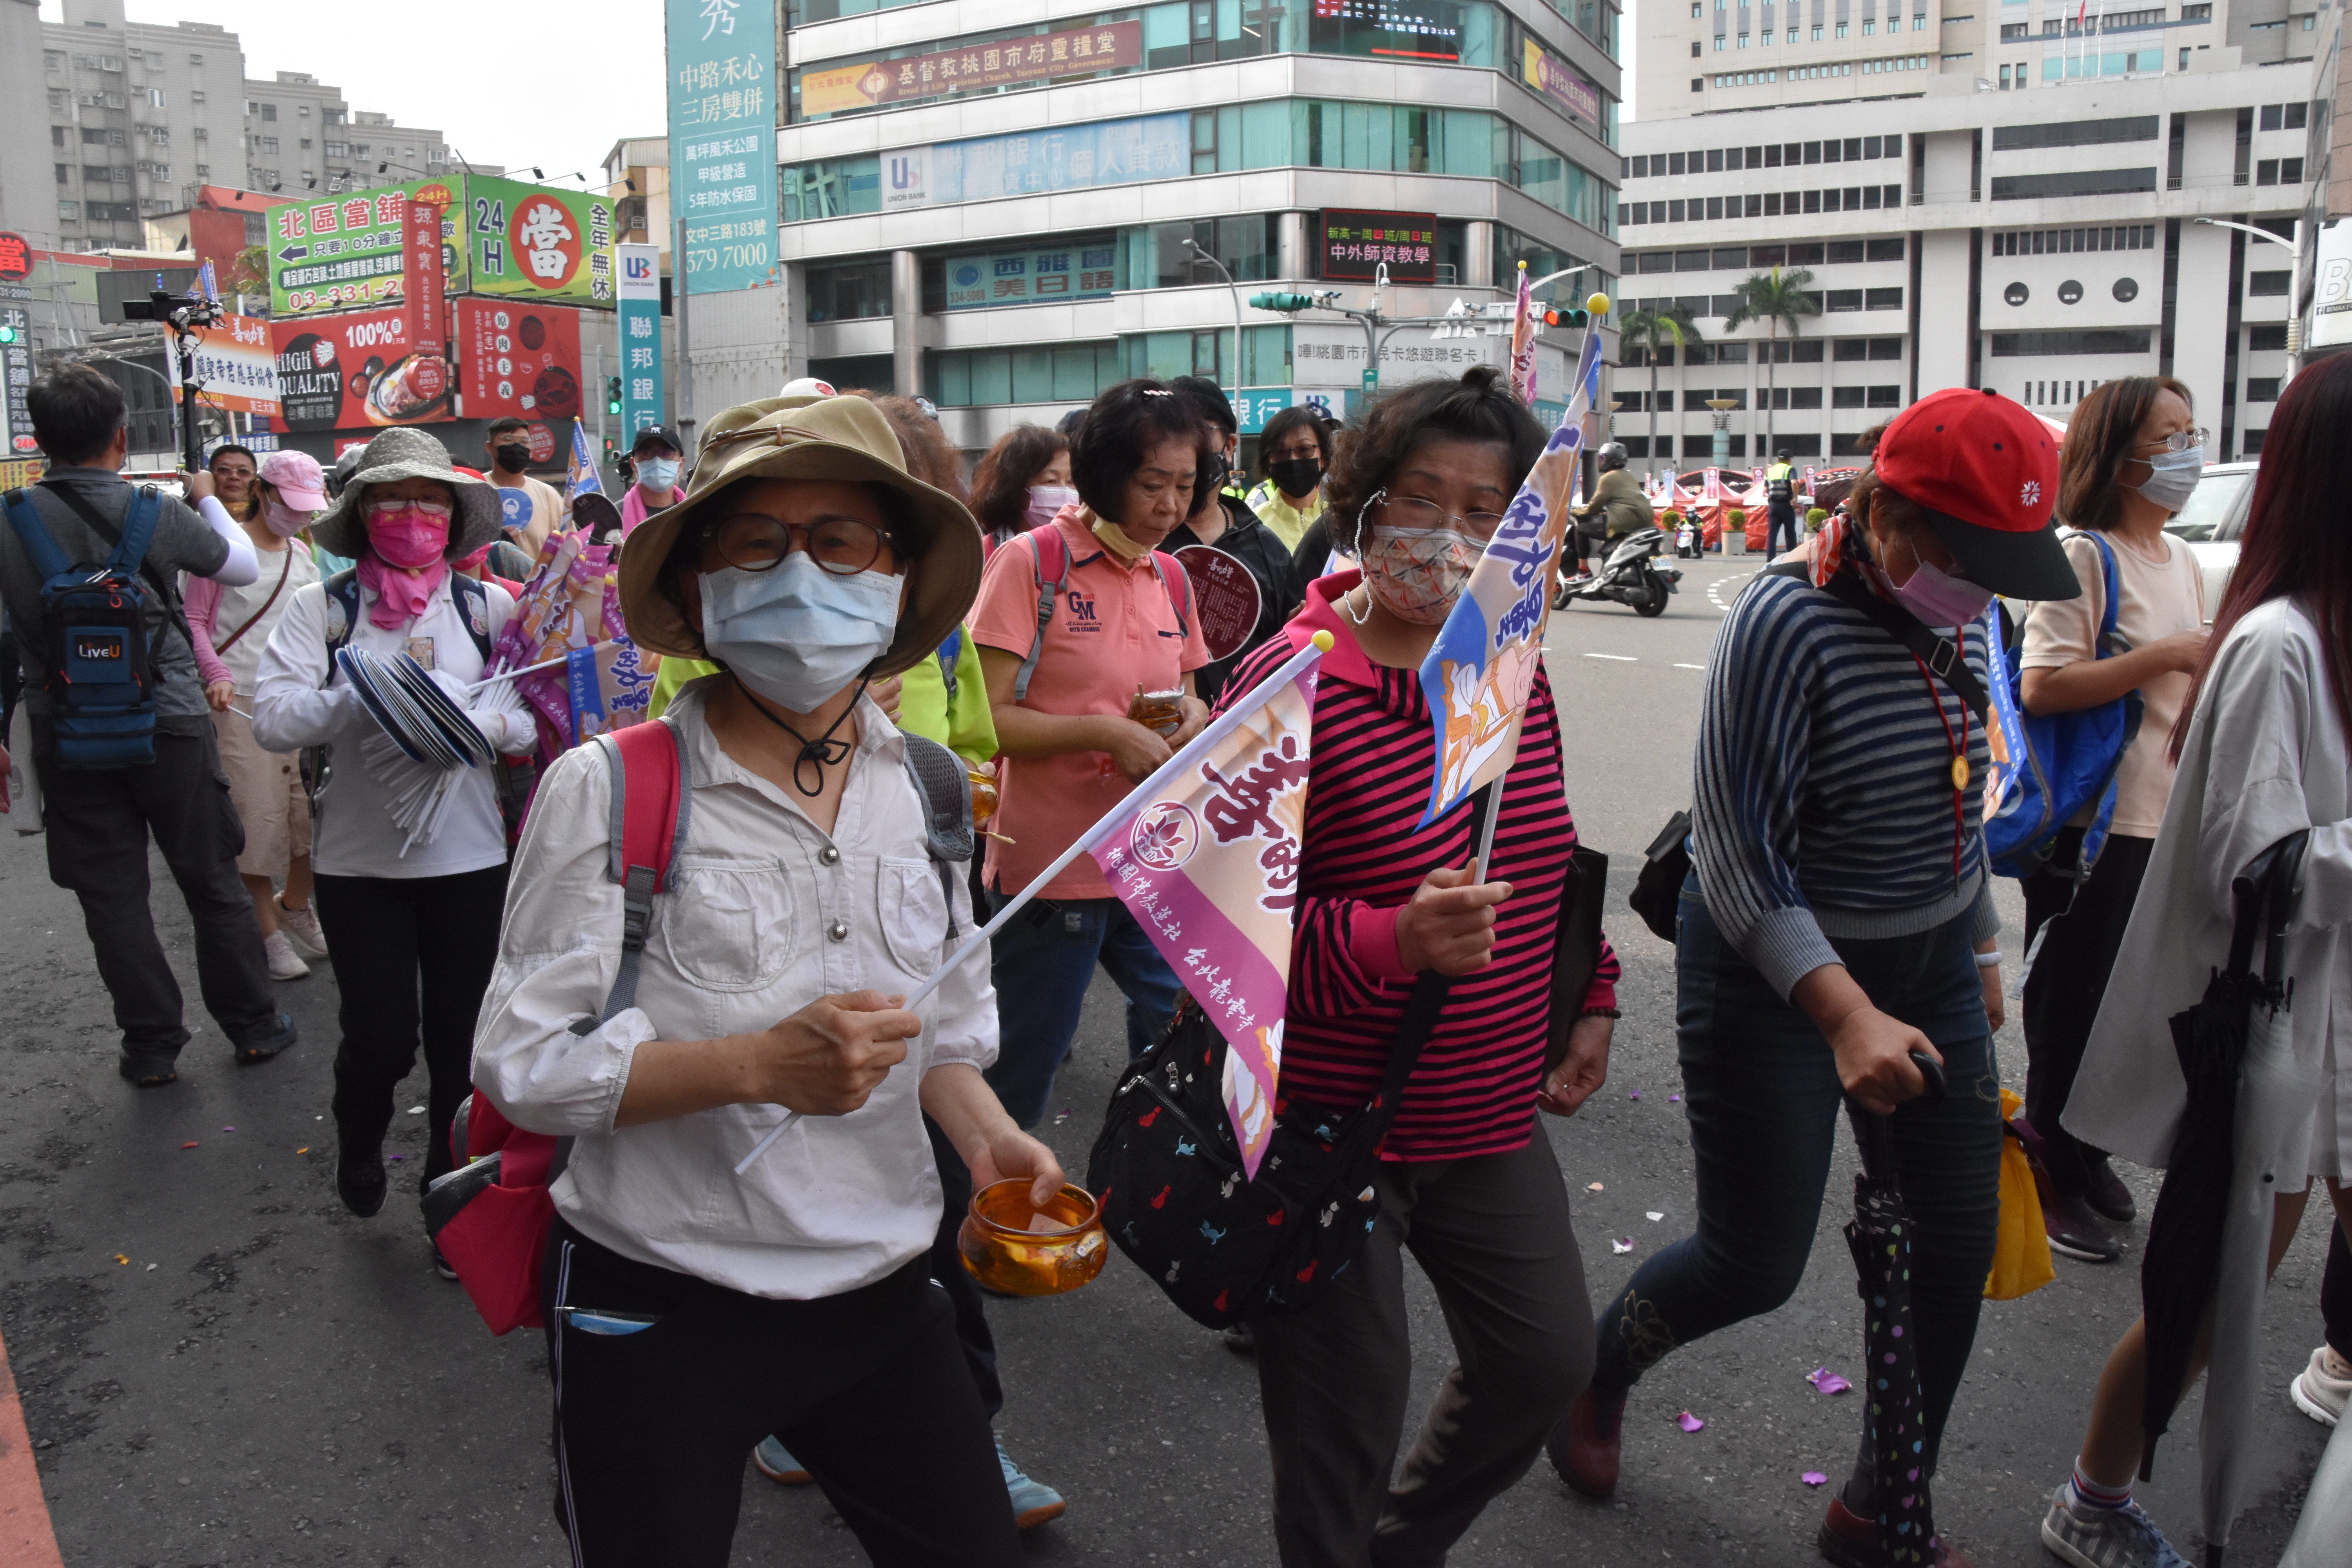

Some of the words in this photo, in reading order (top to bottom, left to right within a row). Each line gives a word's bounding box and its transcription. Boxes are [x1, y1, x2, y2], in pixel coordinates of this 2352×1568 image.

[680, 53, 763, 93] 中路禾心
[898, 31, 1115, 85] 基督教桃園市府靈糧堂
[681, 87, 764, 125] 三房雙併
[685, 136, 758, 161] 萬坪風禾公園
[1069, 141, 1181, 180] 個人貸款
[699, 162, 746, 184] 甲級營造
[417, 190, 447, 202] 24H
[689, 185, 757, 209] 5年防水保固
[888, 194, 907, 202] UNION
[909, 192, 926, 200] BANK
[279, 191, 406, 240] 北區當舖
[475, 198, 505, 234] 24
[685, 219, 767, 244] 文中三路183號
[482, 239, 503, 276] H
[520, 203, 572, 279] 當
[590, 203, 611, 300] 全年無休
[686, 248, 717, 274] 379
[723, 242, 767, 269] 7000
[1331, 243, 1430, 264] 中外師資教學
[4, 310, 29, 386] 北區當舖
[346, 320, 393, 348] 100%
[276, 350, 312, 372] HIGH
[497, 314, 511, 397] 原肉主義
[278, 372, 340, 396] QUALITY
[630, 316, 655, 432] 聯邦銀行
[16, 438, 36, 450] 24H
[79, 643, 120, 658] LiveU
[1107, 847, 1181, 942] 桃園佛教蓮社
[1183, 948, 1255, 1032] 台北龍雲寺
